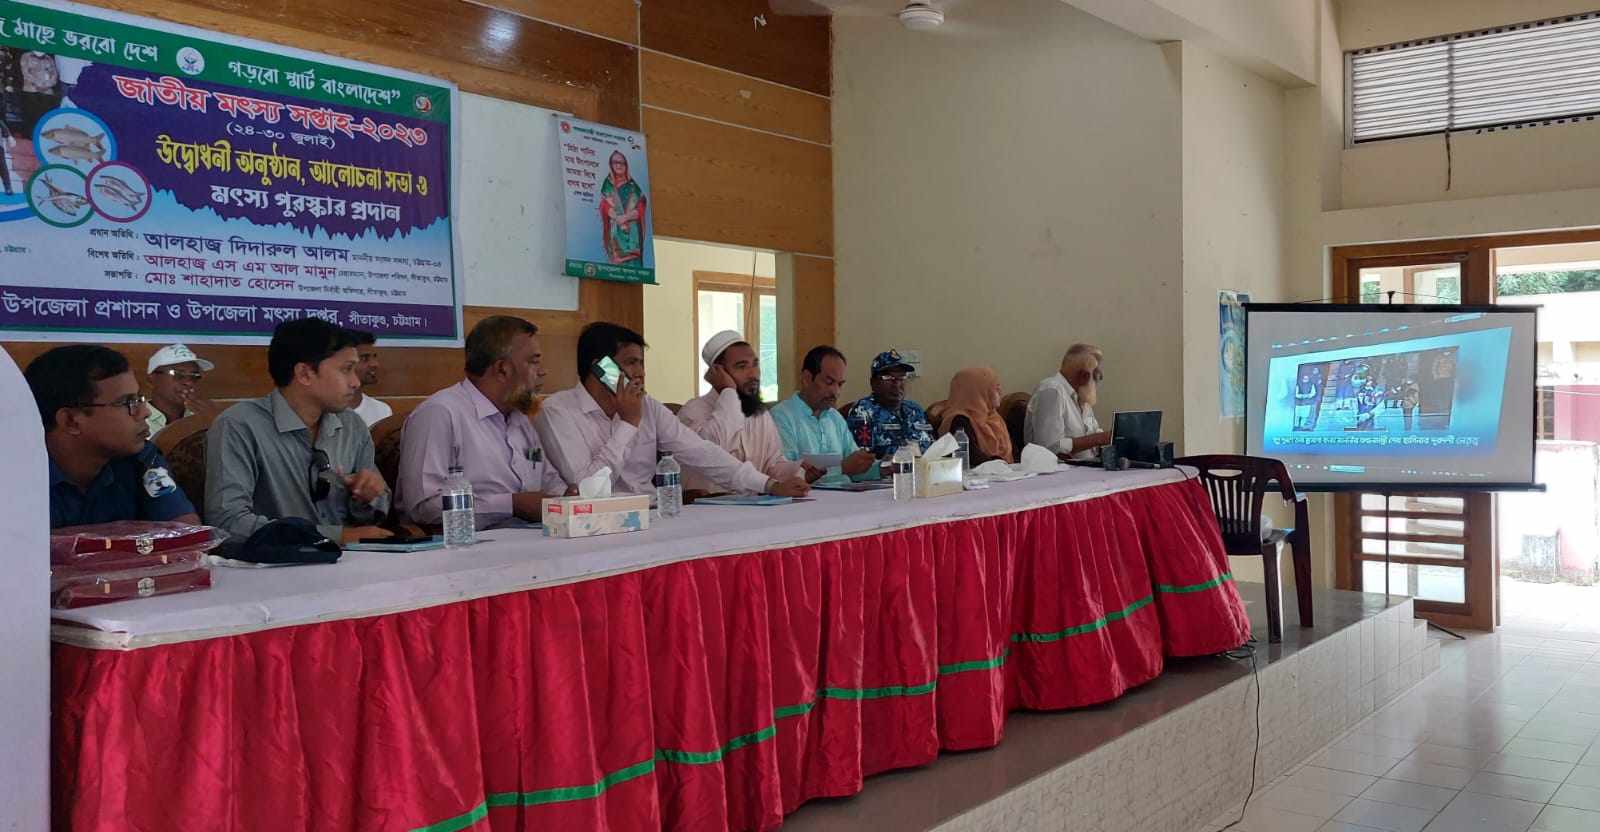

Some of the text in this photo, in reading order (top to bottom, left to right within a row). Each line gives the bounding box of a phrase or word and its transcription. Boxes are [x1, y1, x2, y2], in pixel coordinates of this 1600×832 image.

[14, 17, 56, 45] মাছে
[62, 29, 116, 54] ভরবো
[124, 42, 158, 62] দেশ
[228, 61, 280, 86] গড়বো
[284, 69, 316, 90] স্মার্ট
[112, 75, 428, 148] জাতীয় মৎস্য সপ্তাহ-২০২৩
[226, 121, 336, 150] (২৪-৩০ জুলাই)
[155, 135, 428, 196] উদ্বোধনী অনুষ্ঠান, আলোচনা সভা ও
[209, 185, 401, 223] মৎস্য পুরস্কার প্রদান
[228, 236, 297, 258] দিদারুল
[302, 245, 351, 262] আলম
[145, 272, 296, 291] মোঃ শাহাদাত হোসেন
[212, 260, 236, 272] এস
[243, 262, 265, 274] এম
[271, 263, 299, 276] আল
[303, 265, 337, 280] মামুন
[1, 291, 88, 319] উপজেলা
[94, 298, 161, 320] প্রশাসন
[166, 303, 181, 319] ও
[186, 298, 259, 324] উপজেলা
